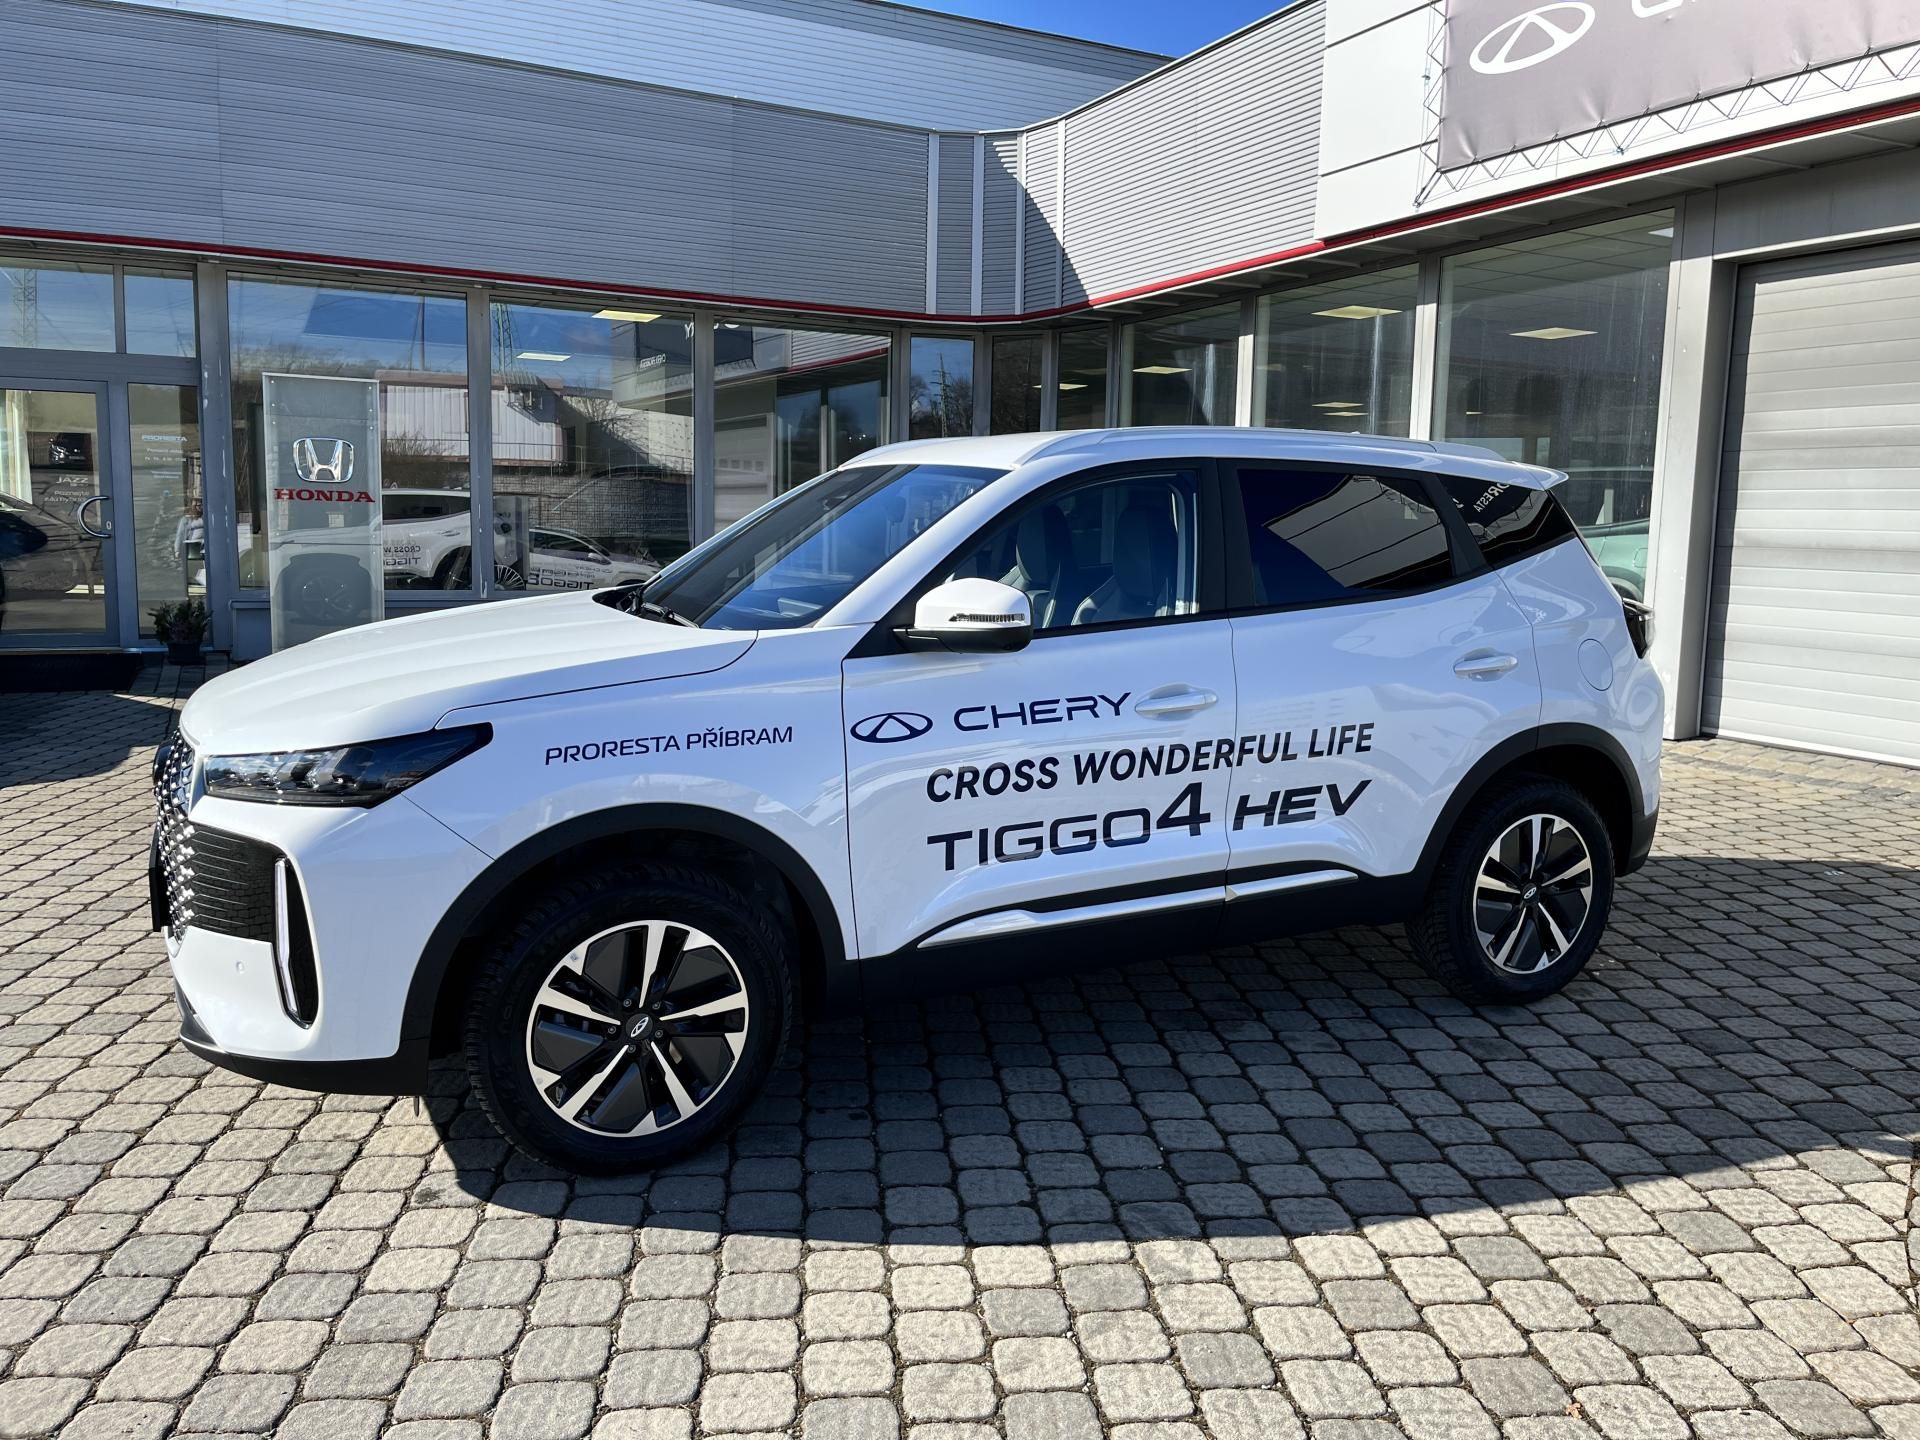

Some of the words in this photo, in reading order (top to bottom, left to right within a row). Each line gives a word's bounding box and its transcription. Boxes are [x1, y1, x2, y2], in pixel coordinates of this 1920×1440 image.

[56, 476, 88, 484] JAZZ
[273, 488, 376, 503] HONDA
[953, 692, 1131, 731] CHERY
[545, 735, 681, 765] PRORESTA
[686, 726, 793, 750] PŘÍBRAM
[926, 756, 1060, 803] CROSS
[1073, 731, 1298, 785] WONDERFUL
[1307, 722, 1375, 758] LIFE
[1232, 779, 1373, 831] HEV
